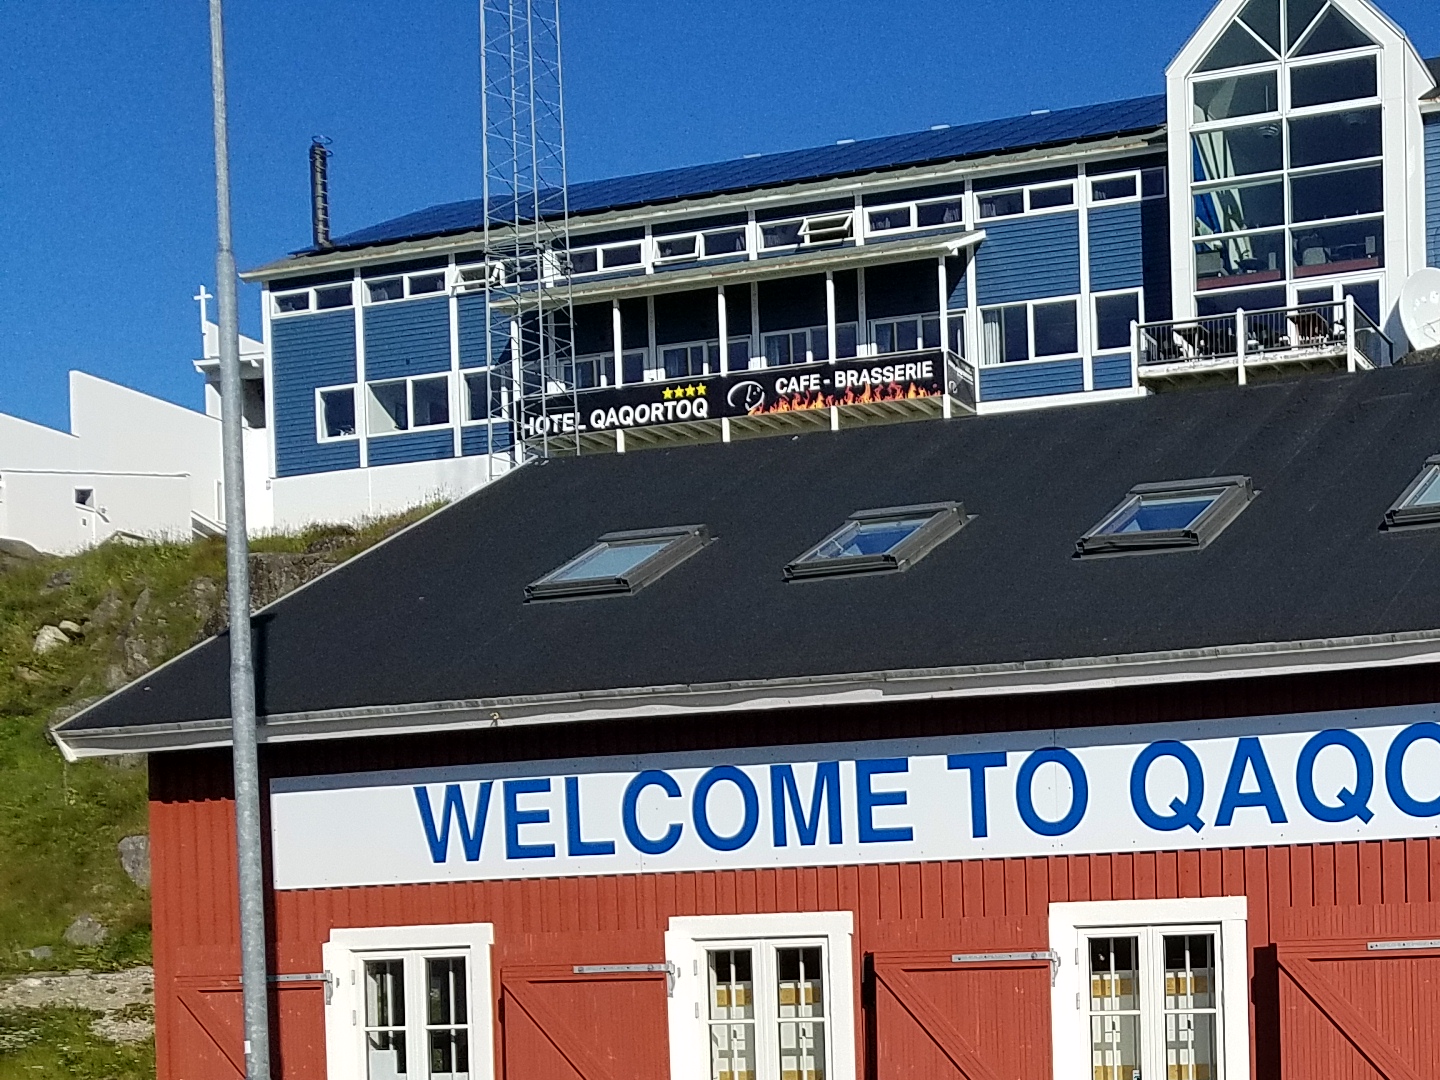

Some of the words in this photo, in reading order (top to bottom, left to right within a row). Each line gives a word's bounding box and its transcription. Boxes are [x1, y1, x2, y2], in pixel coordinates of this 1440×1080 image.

[774, 374, 821, 394] CAFE
[834, 361, 934, 389] BRASSERIE
[522, 411, 586, 436] HOTEL
[590, 397, 709, 429] QAQORTOQ
[415, 758, 913, 863] WELCOME
[948, 748, 1088, 836] TO
